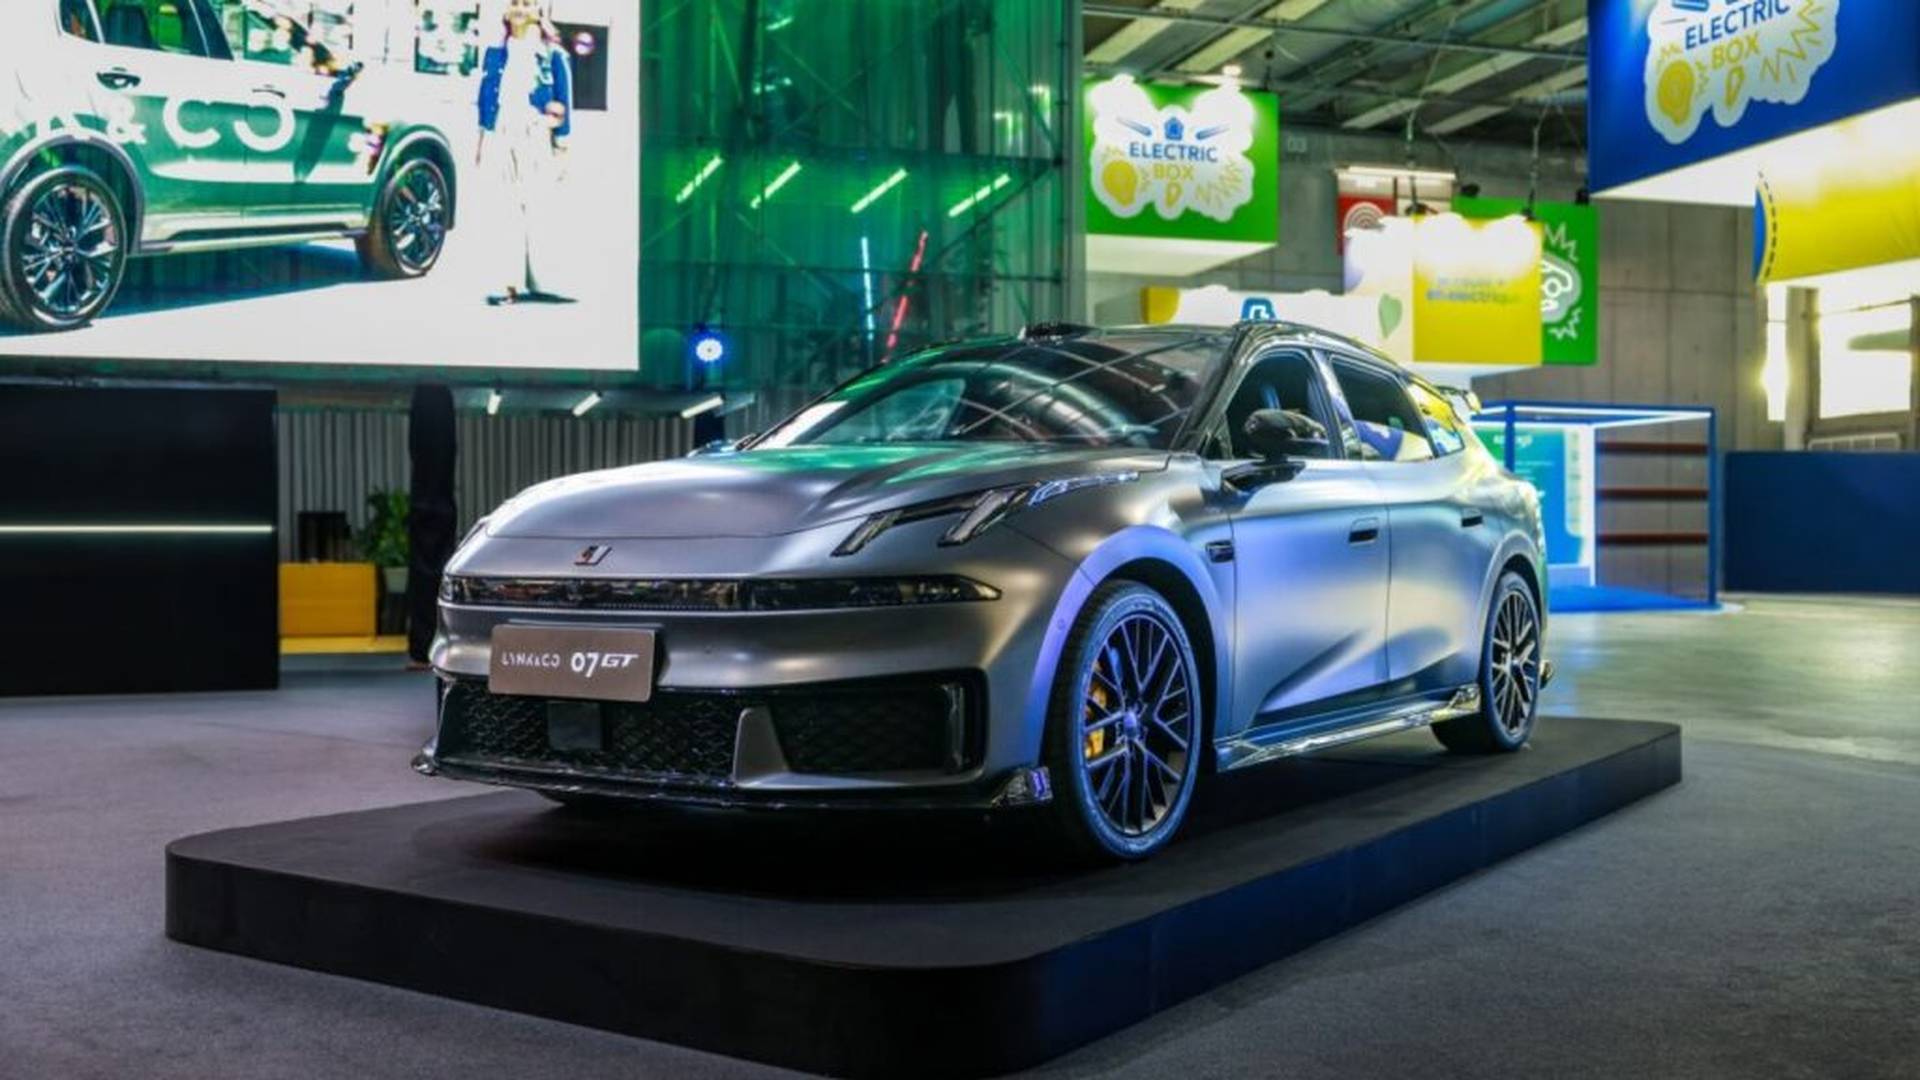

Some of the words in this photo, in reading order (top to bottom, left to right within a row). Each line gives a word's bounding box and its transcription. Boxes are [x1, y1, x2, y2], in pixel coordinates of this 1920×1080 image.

[1685, 0, 1791, 50] ELECTRIC
[1711, 31, 1760, 70] BOX
[1129, 141, 1218, 163] ELECTRIC
[1153, 163, 1195, 181] BOX
